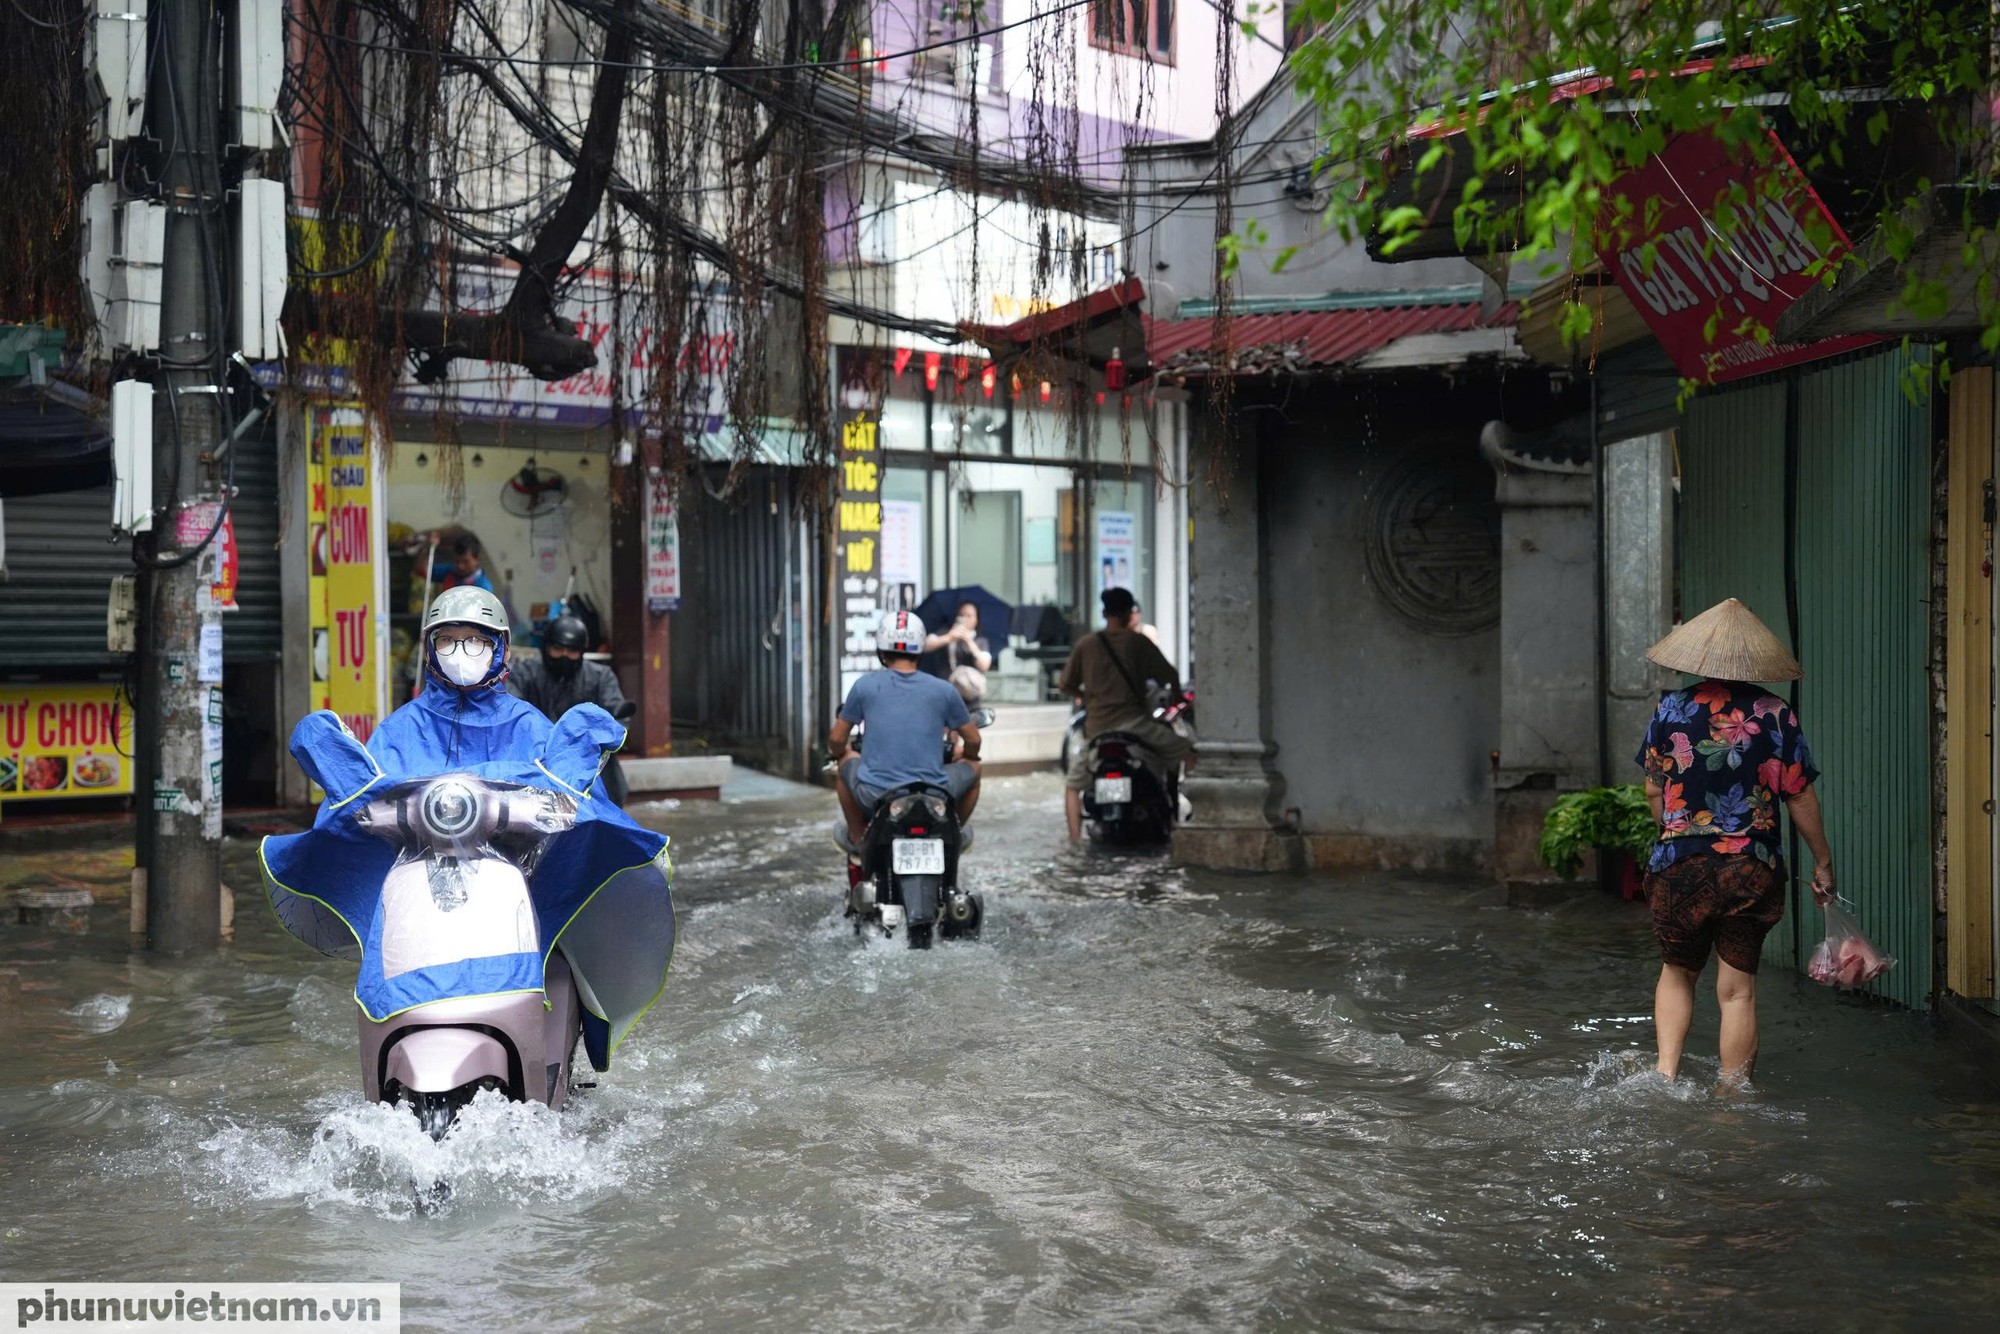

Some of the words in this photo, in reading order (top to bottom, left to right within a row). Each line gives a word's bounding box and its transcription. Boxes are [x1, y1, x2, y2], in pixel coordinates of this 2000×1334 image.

[1619, 246, 1700, 317] GIA
[330, 463, 365, 487] CHÂU
[843, 456, 878, 492] TÓC
[329, 501, 370, 565] CƠM
[840, 501, 881, 532] NAM
[846, 537, 875, 572] NỮ
[335, 604, 368, 682] TỰ
[37, 700, 120, 757] CHỌN
